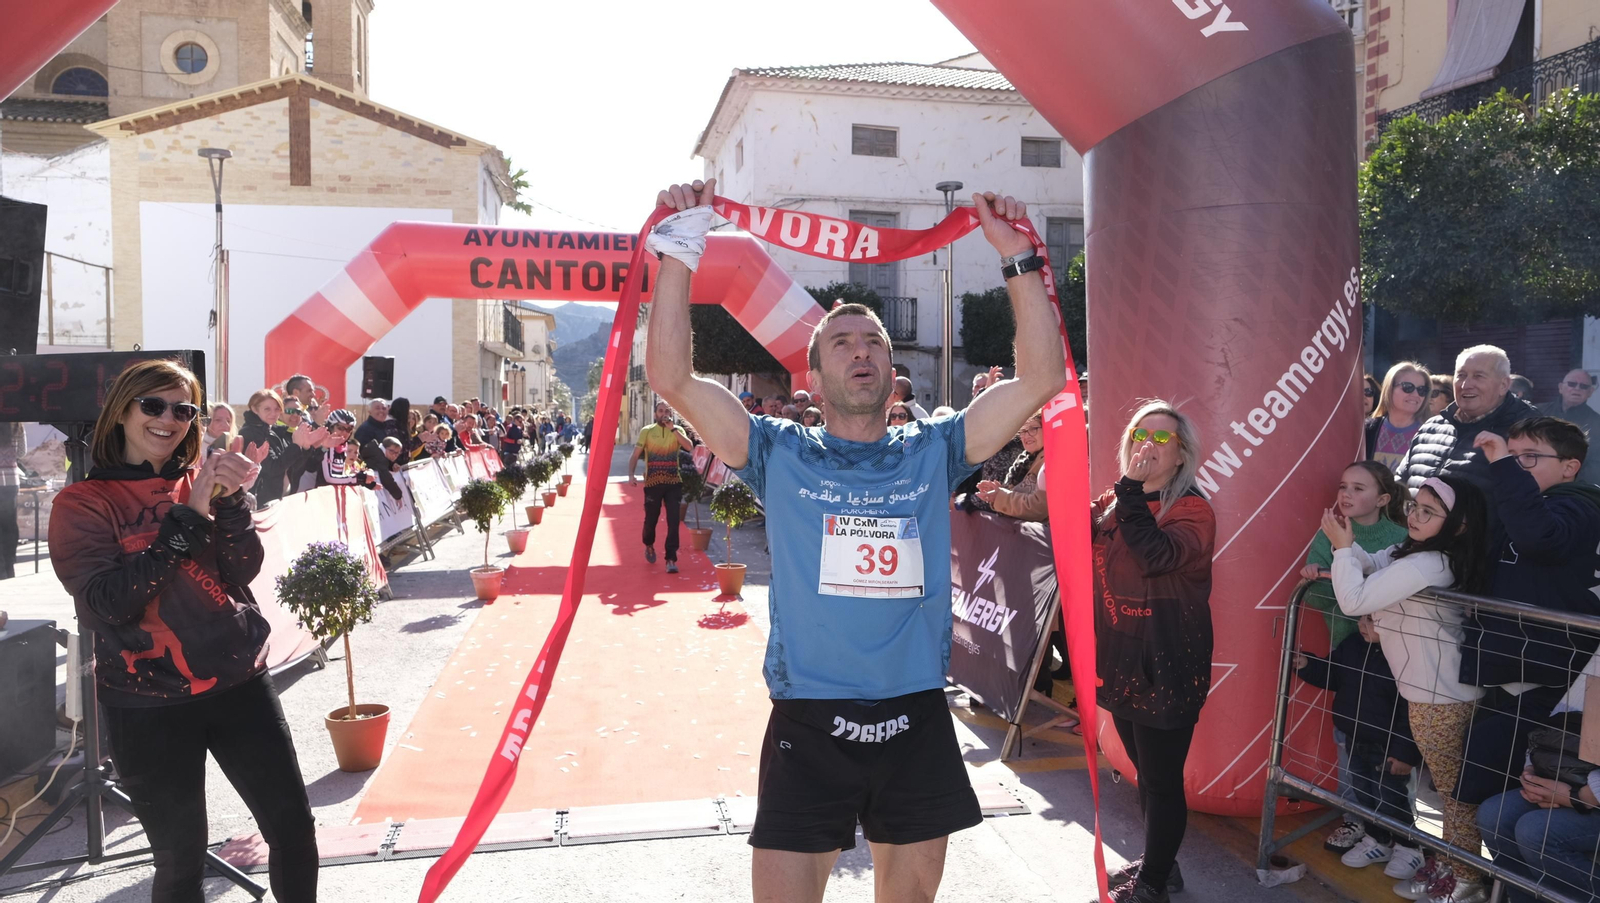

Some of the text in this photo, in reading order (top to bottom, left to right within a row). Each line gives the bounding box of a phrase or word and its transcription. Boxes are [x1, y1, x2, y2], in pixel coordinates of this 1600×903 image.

[469, 257, 650, 293] CANTORI
[1194, 266, 1361, 501] ww.teamergy.es
[835, 528, 847, 537] LA
[839, 516, 851, 526] IV
[855, 543, 898, 576] 39
